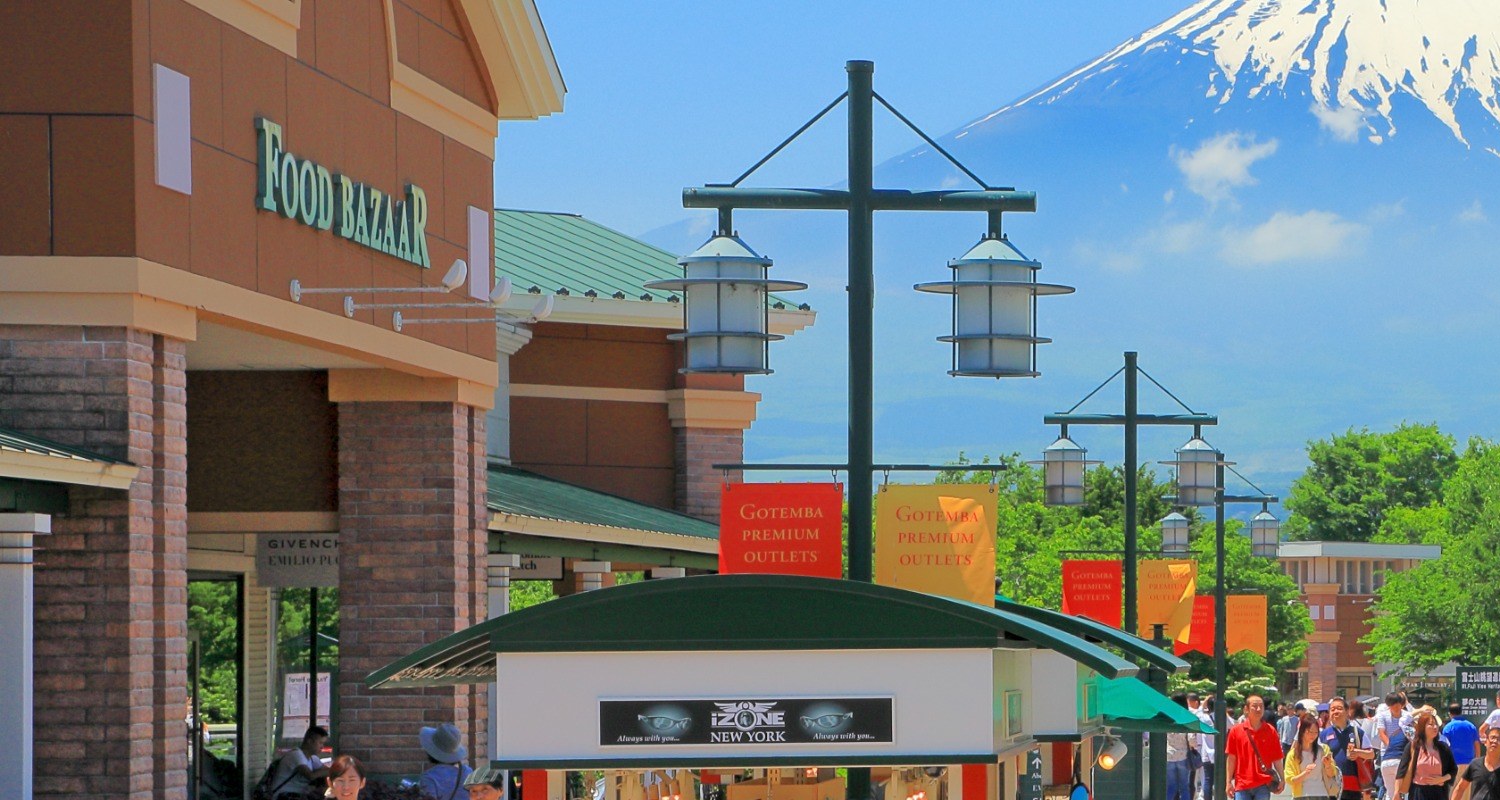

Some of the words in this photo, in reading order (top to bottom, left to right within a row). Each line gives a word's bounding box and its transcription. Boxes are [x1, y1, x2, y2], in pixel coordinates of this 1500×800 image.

[257, 118, 334, 230] FOOD
[335, 173, 431, 268] BAZAAR
[740, 503, 825, 520] GOTEMBA
[896, 505, 979, 523] GOTEMBA
[742, 528, 820, 541] PREMIUM
[898, 531, 975, 545] PREMIUM
[269, 555, 306, 565] EMILIO
[744, 550, 818, 563] OUTLETS
[899, 553, 972, 566] OUTLETS
[617, 735, 643, 743] Always
[710, 731, 743, 743] NEW
[747, 731, 786, 742] YORK
[813, 733, 839, 741] Always
